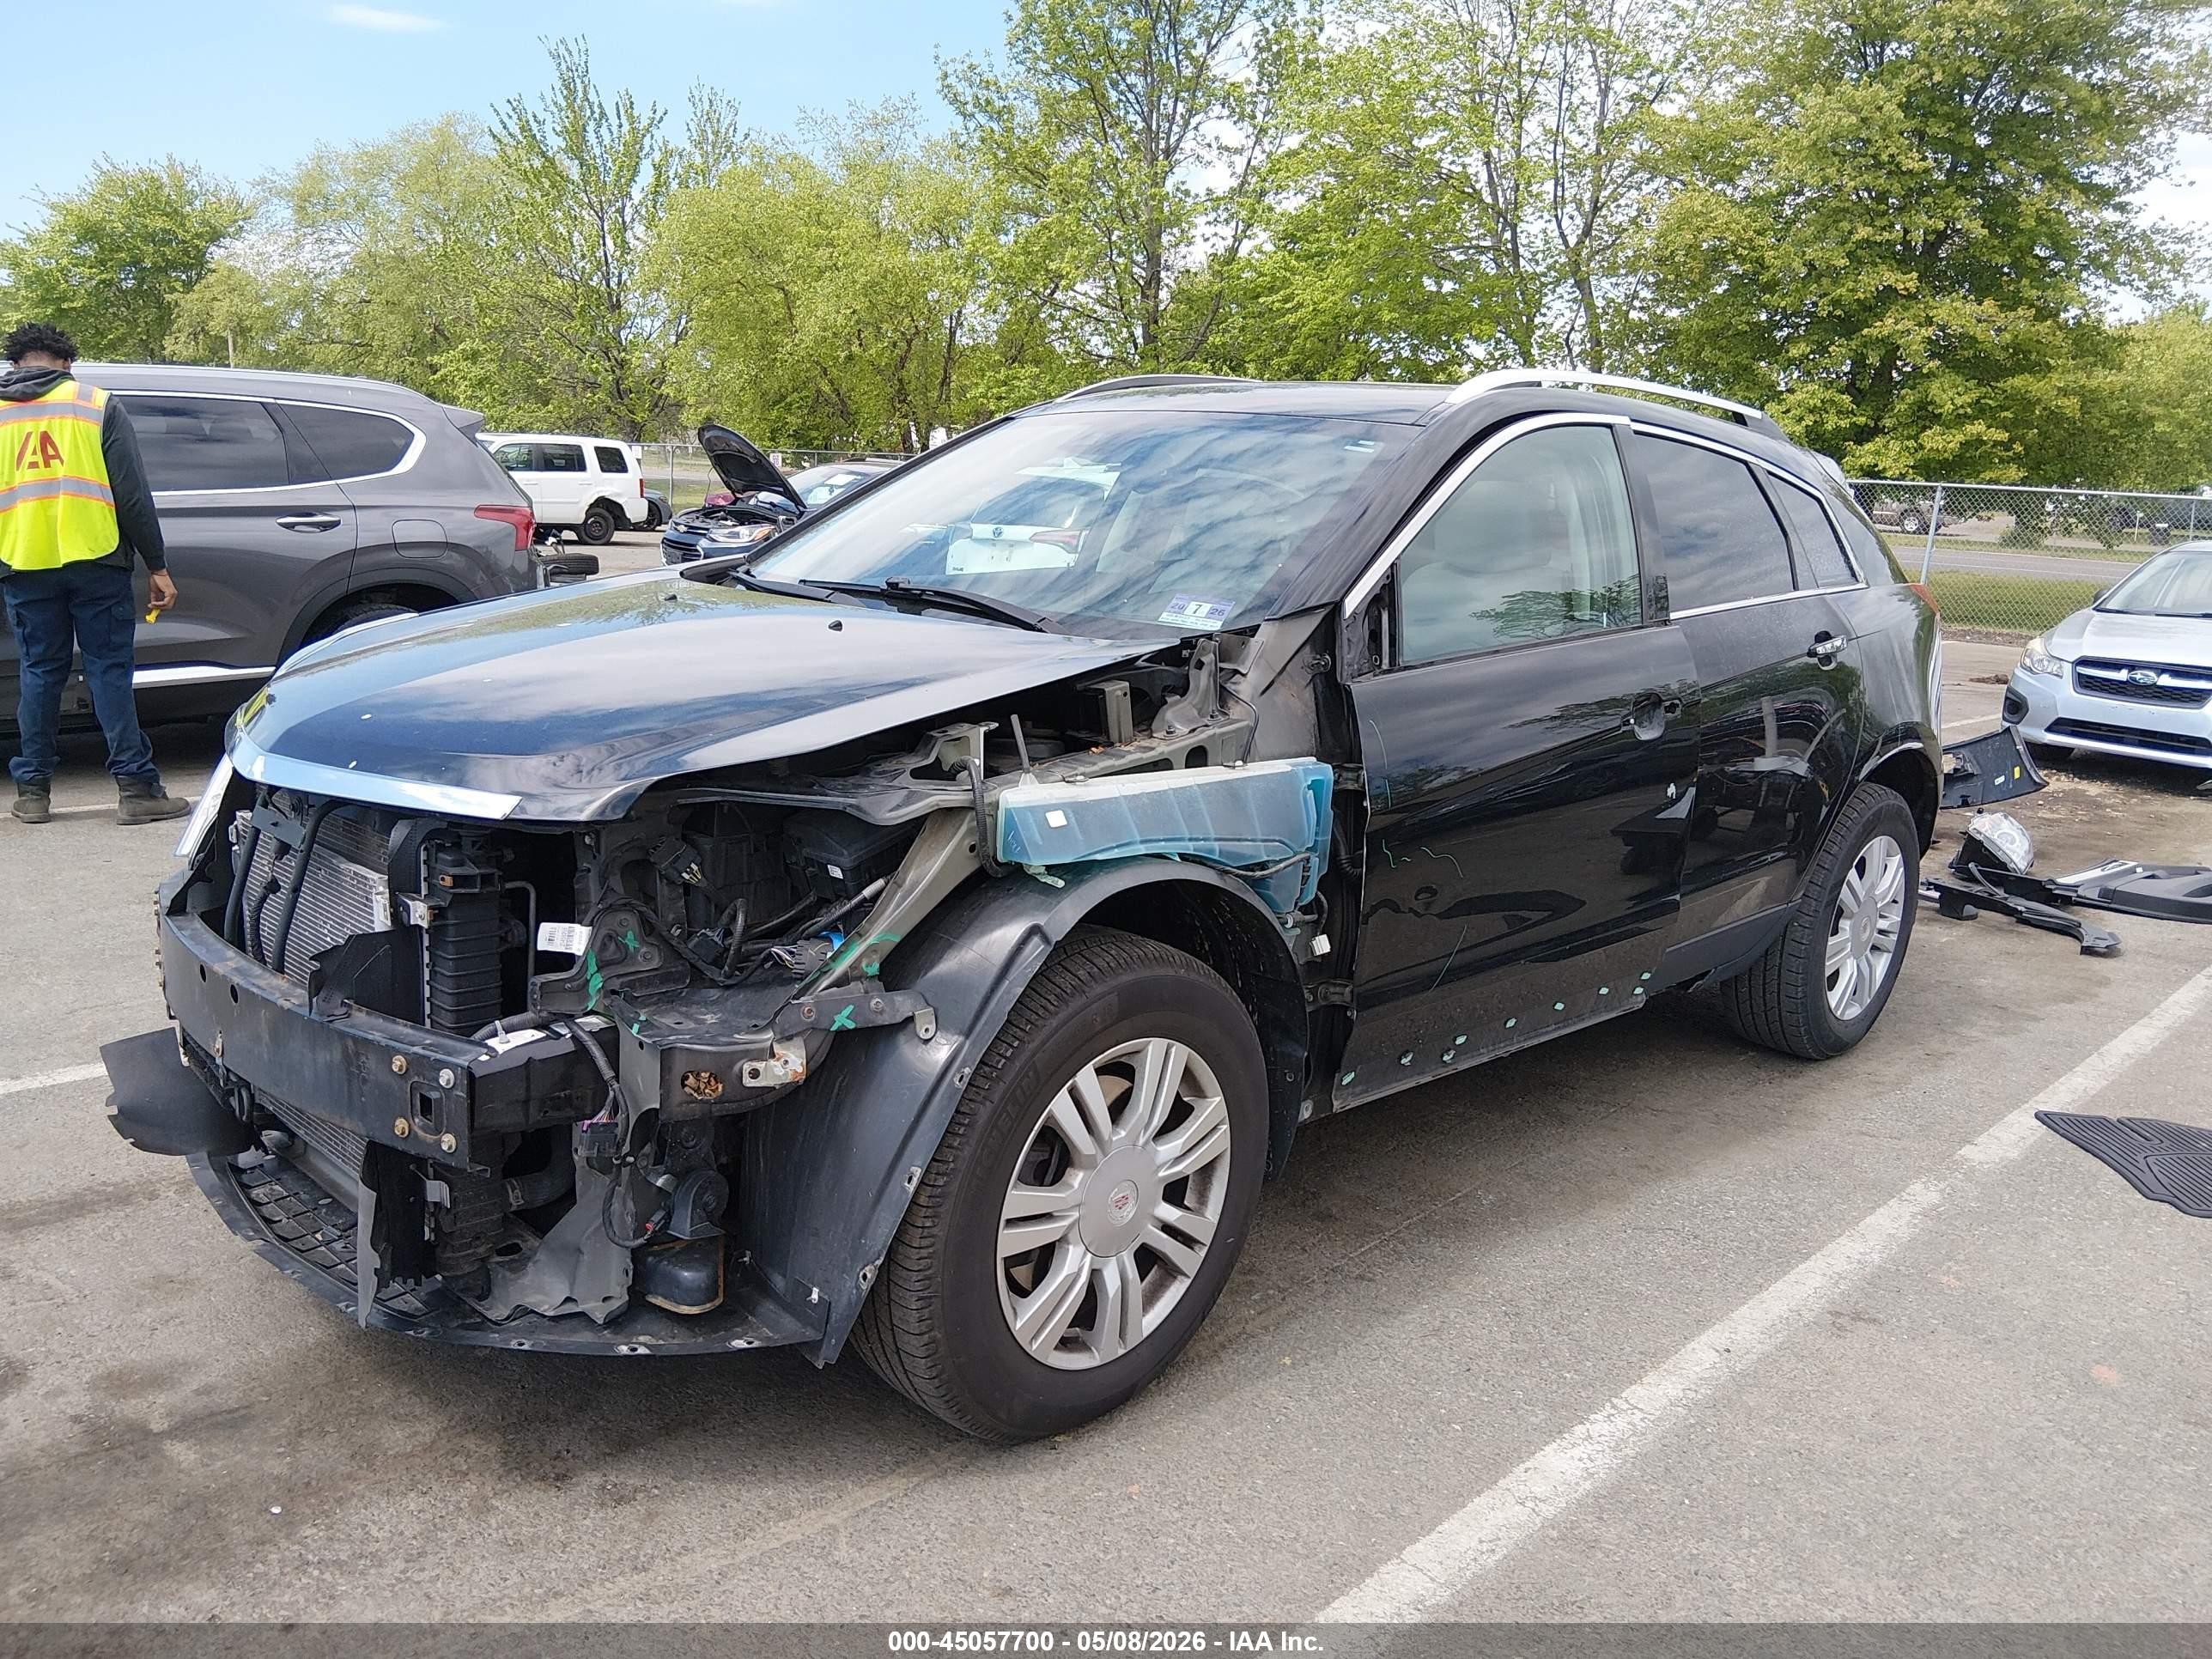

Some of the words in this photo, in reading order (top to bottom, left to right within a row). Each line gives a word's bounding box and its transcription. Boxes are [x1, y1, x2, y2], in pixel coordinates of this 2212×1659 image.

[1170, 602, 1186, 611] 20
[1193, 604, 1203, 615] 7
[1209, 608, 1226, 617] 26
